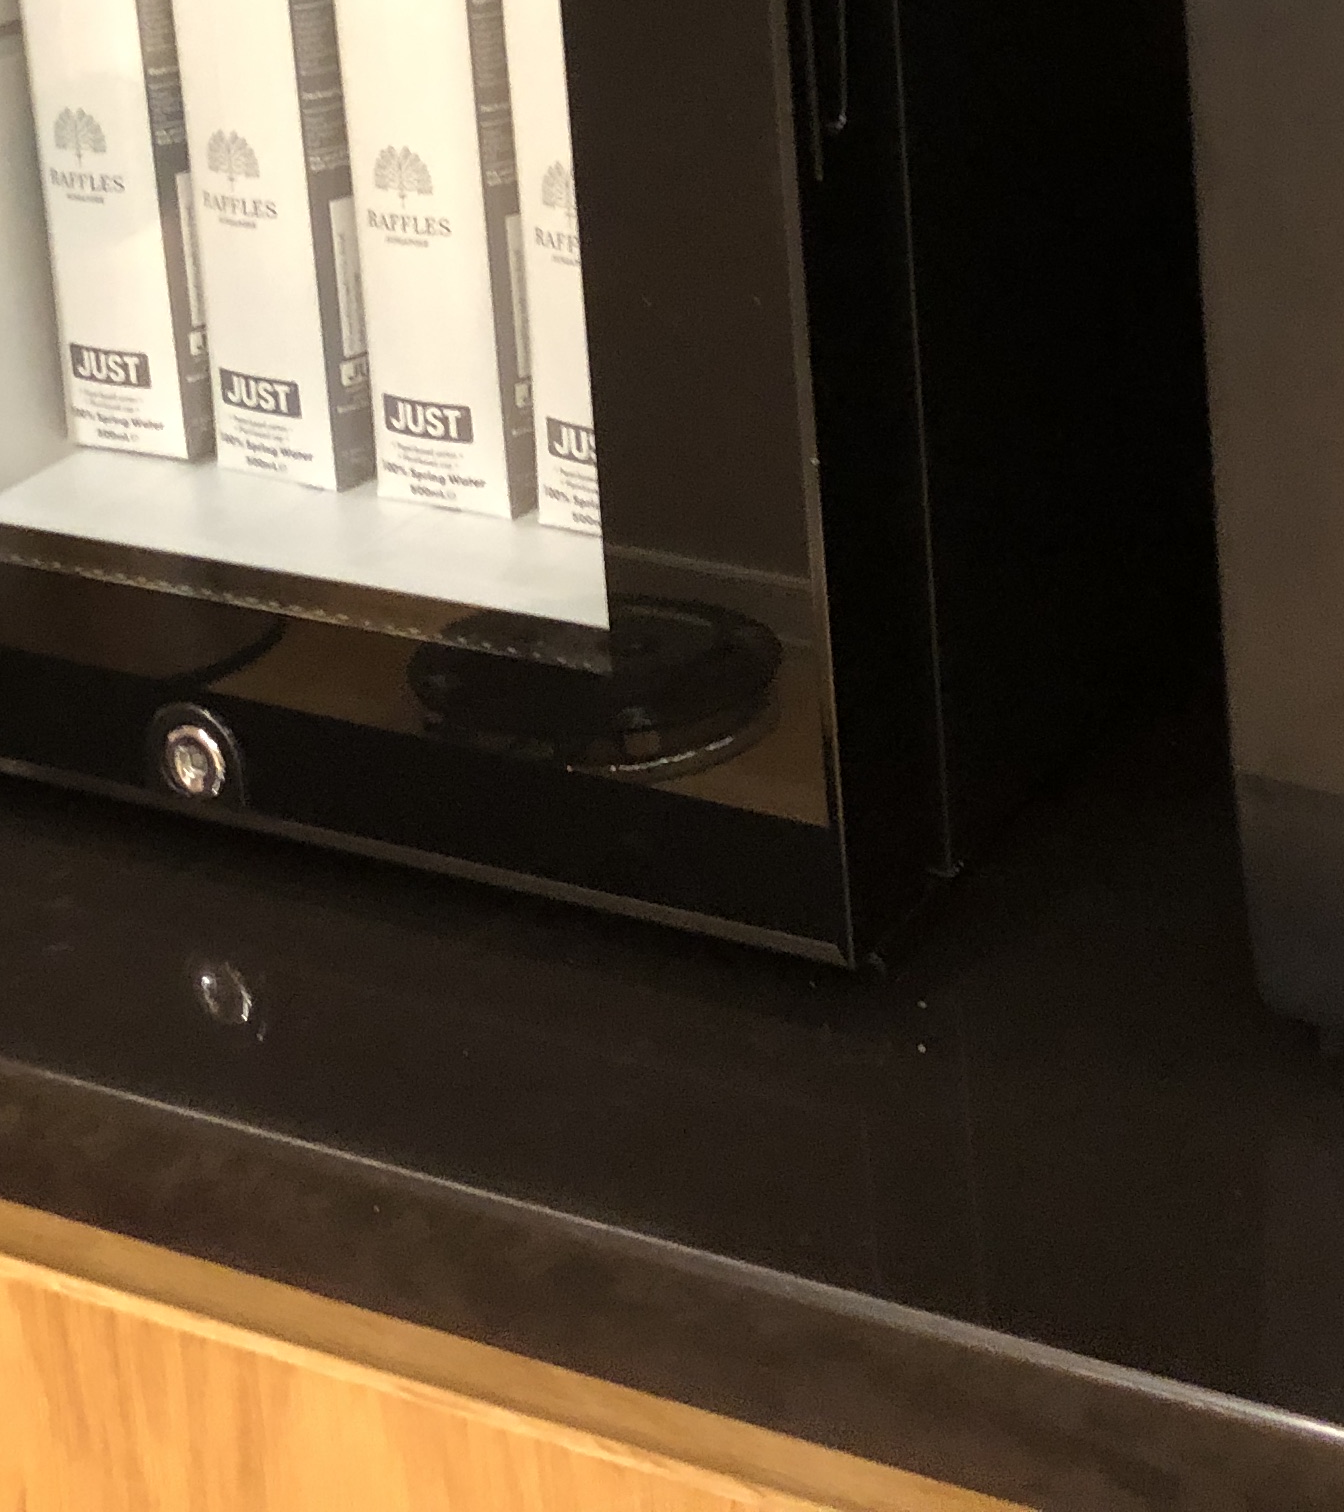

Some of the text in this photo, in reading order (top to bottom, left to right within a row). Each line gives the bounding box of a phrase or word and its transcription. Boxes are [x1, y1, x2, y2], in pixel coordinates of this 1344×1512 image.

[49, 167, 125, 193] RAFFLES
[202, 190, 278, 219] RAFFLES
[367, 208, 452, 237] RAFFLES
[535, 226, 579, 253] RAFF
[76, 349, 140, 385] JUST
[226, 374, 291, 414] JUST
[390, 400, 461, 439] JUST
[553, 425, 597, 463] JU
